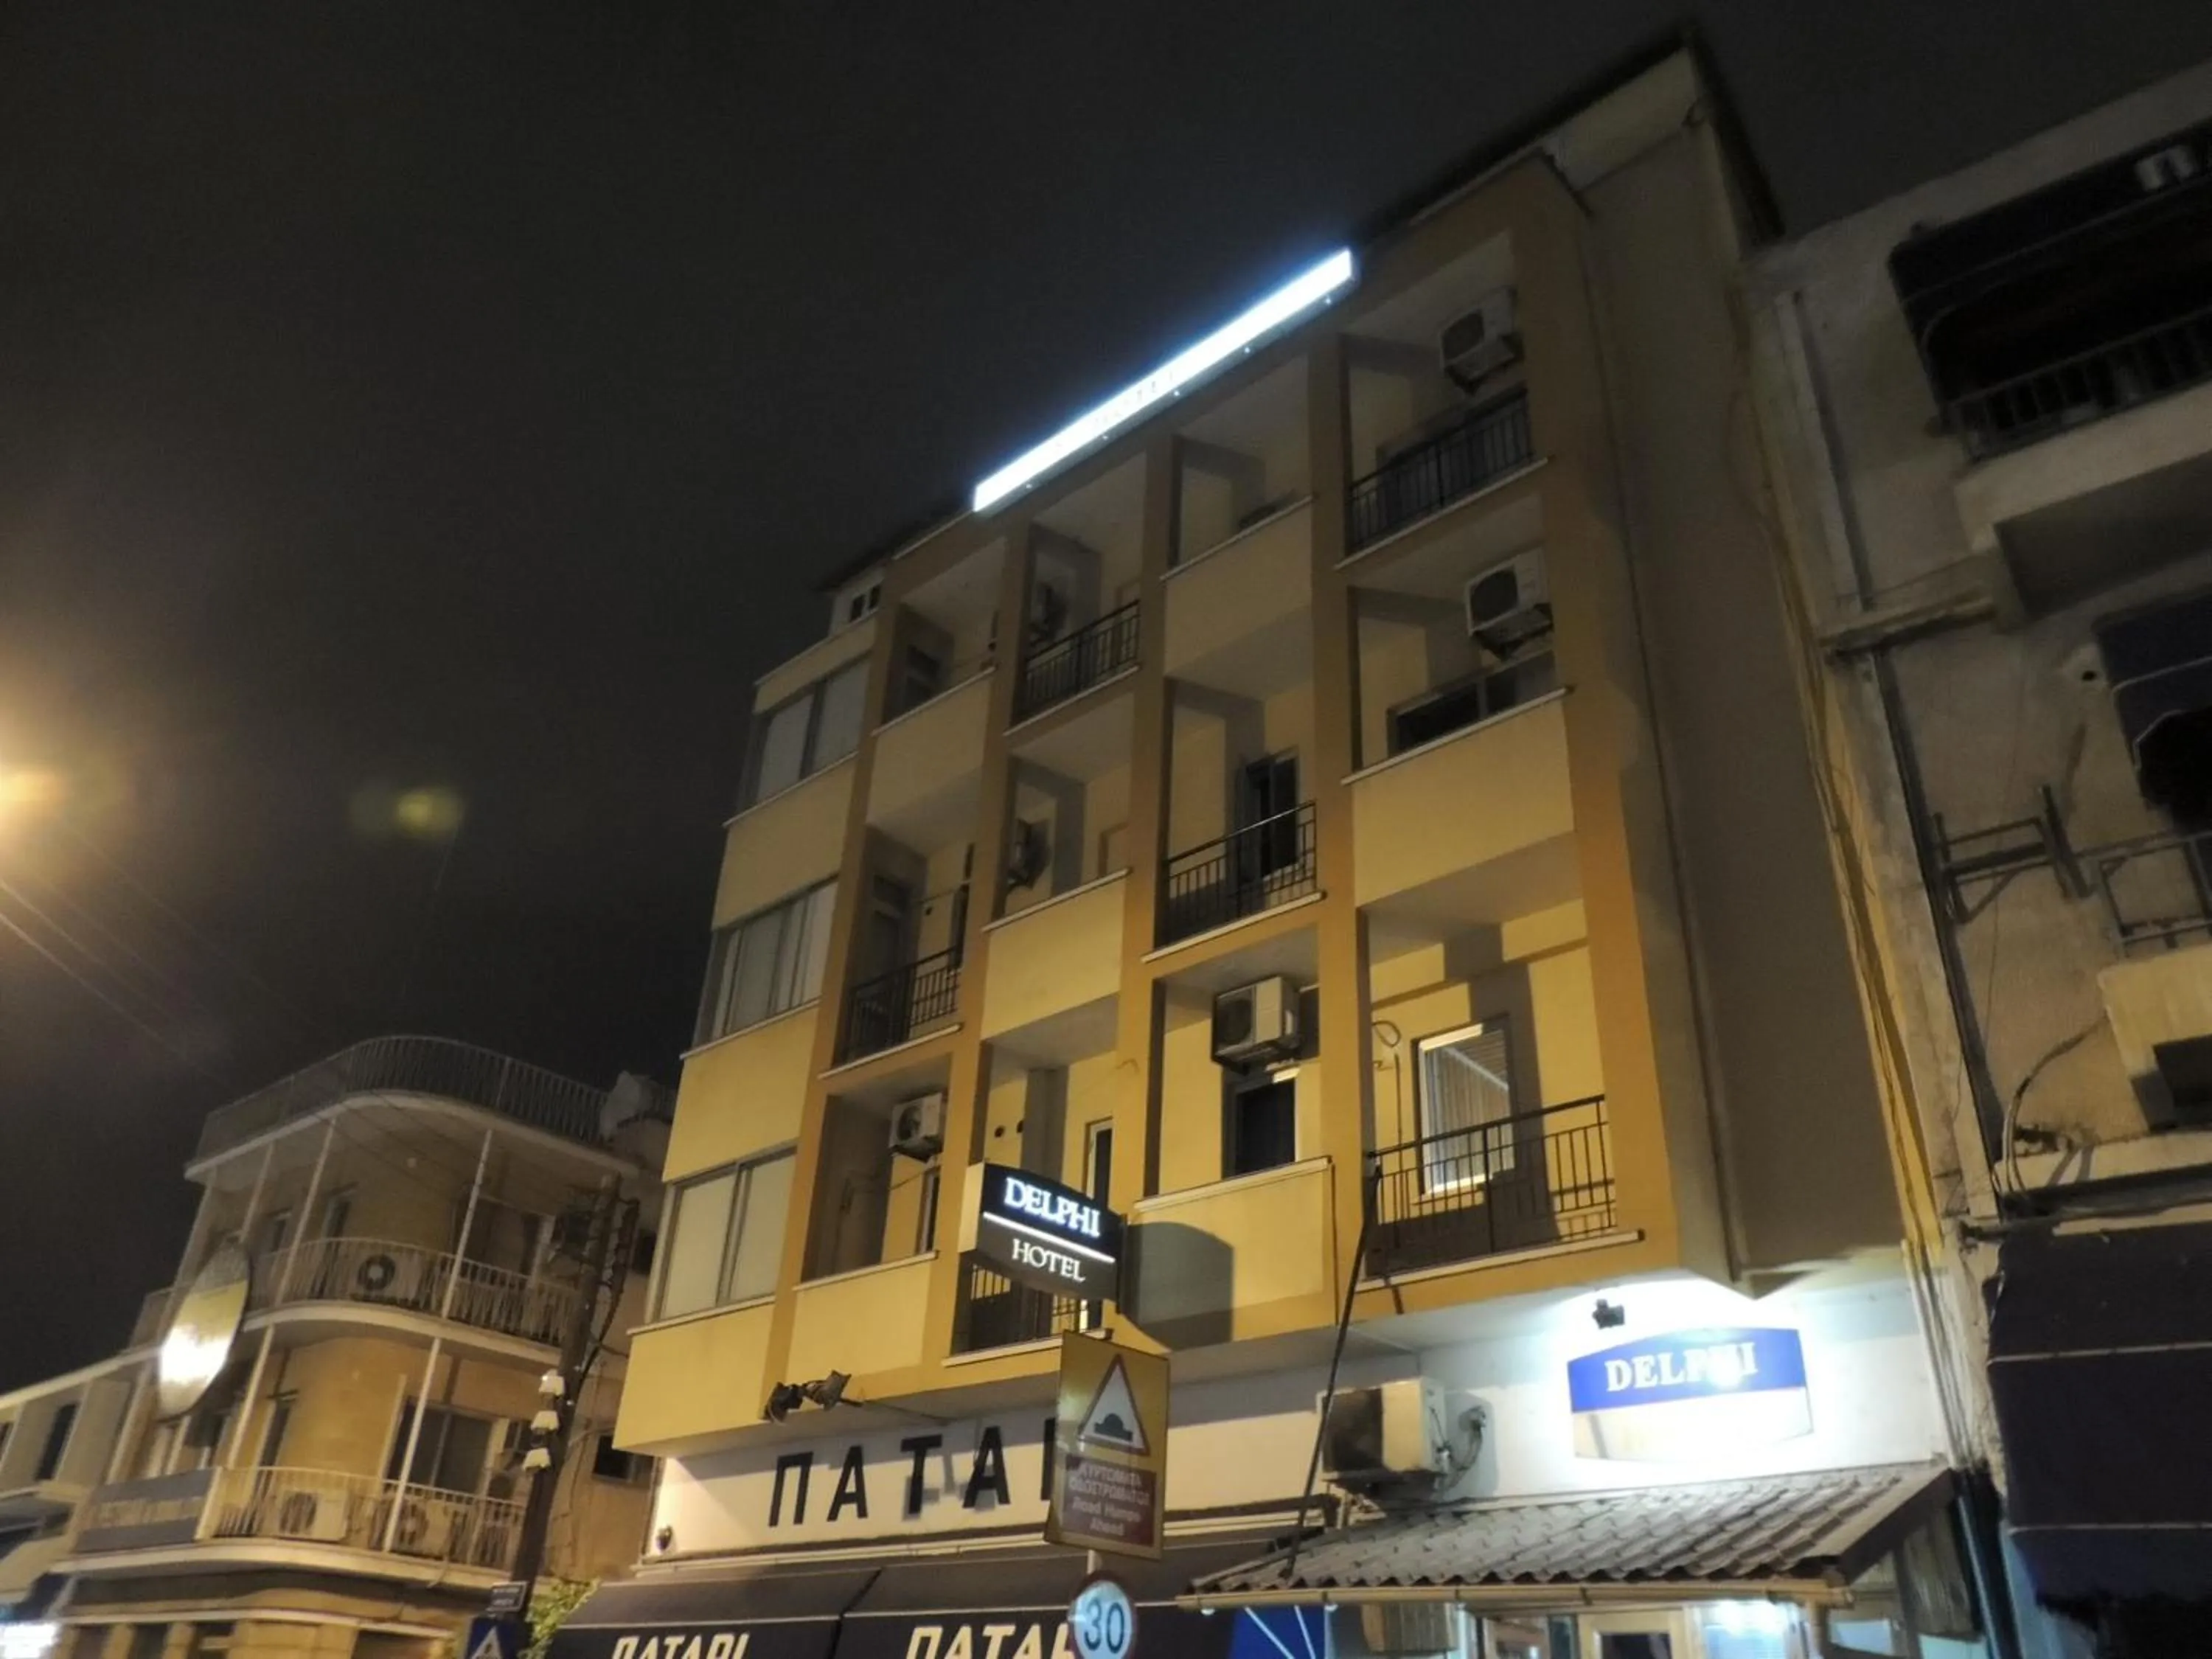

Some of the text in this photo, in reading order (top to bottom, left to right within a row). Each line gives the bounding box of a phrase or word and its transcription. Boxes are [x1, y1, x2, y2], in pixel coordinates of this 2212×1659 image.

[1004, 1177, 1101, 1238] DELPHI
[1012, 1239, 1085, 1282] HOTEL
[1084, 1596, 1124, 1654] 30
